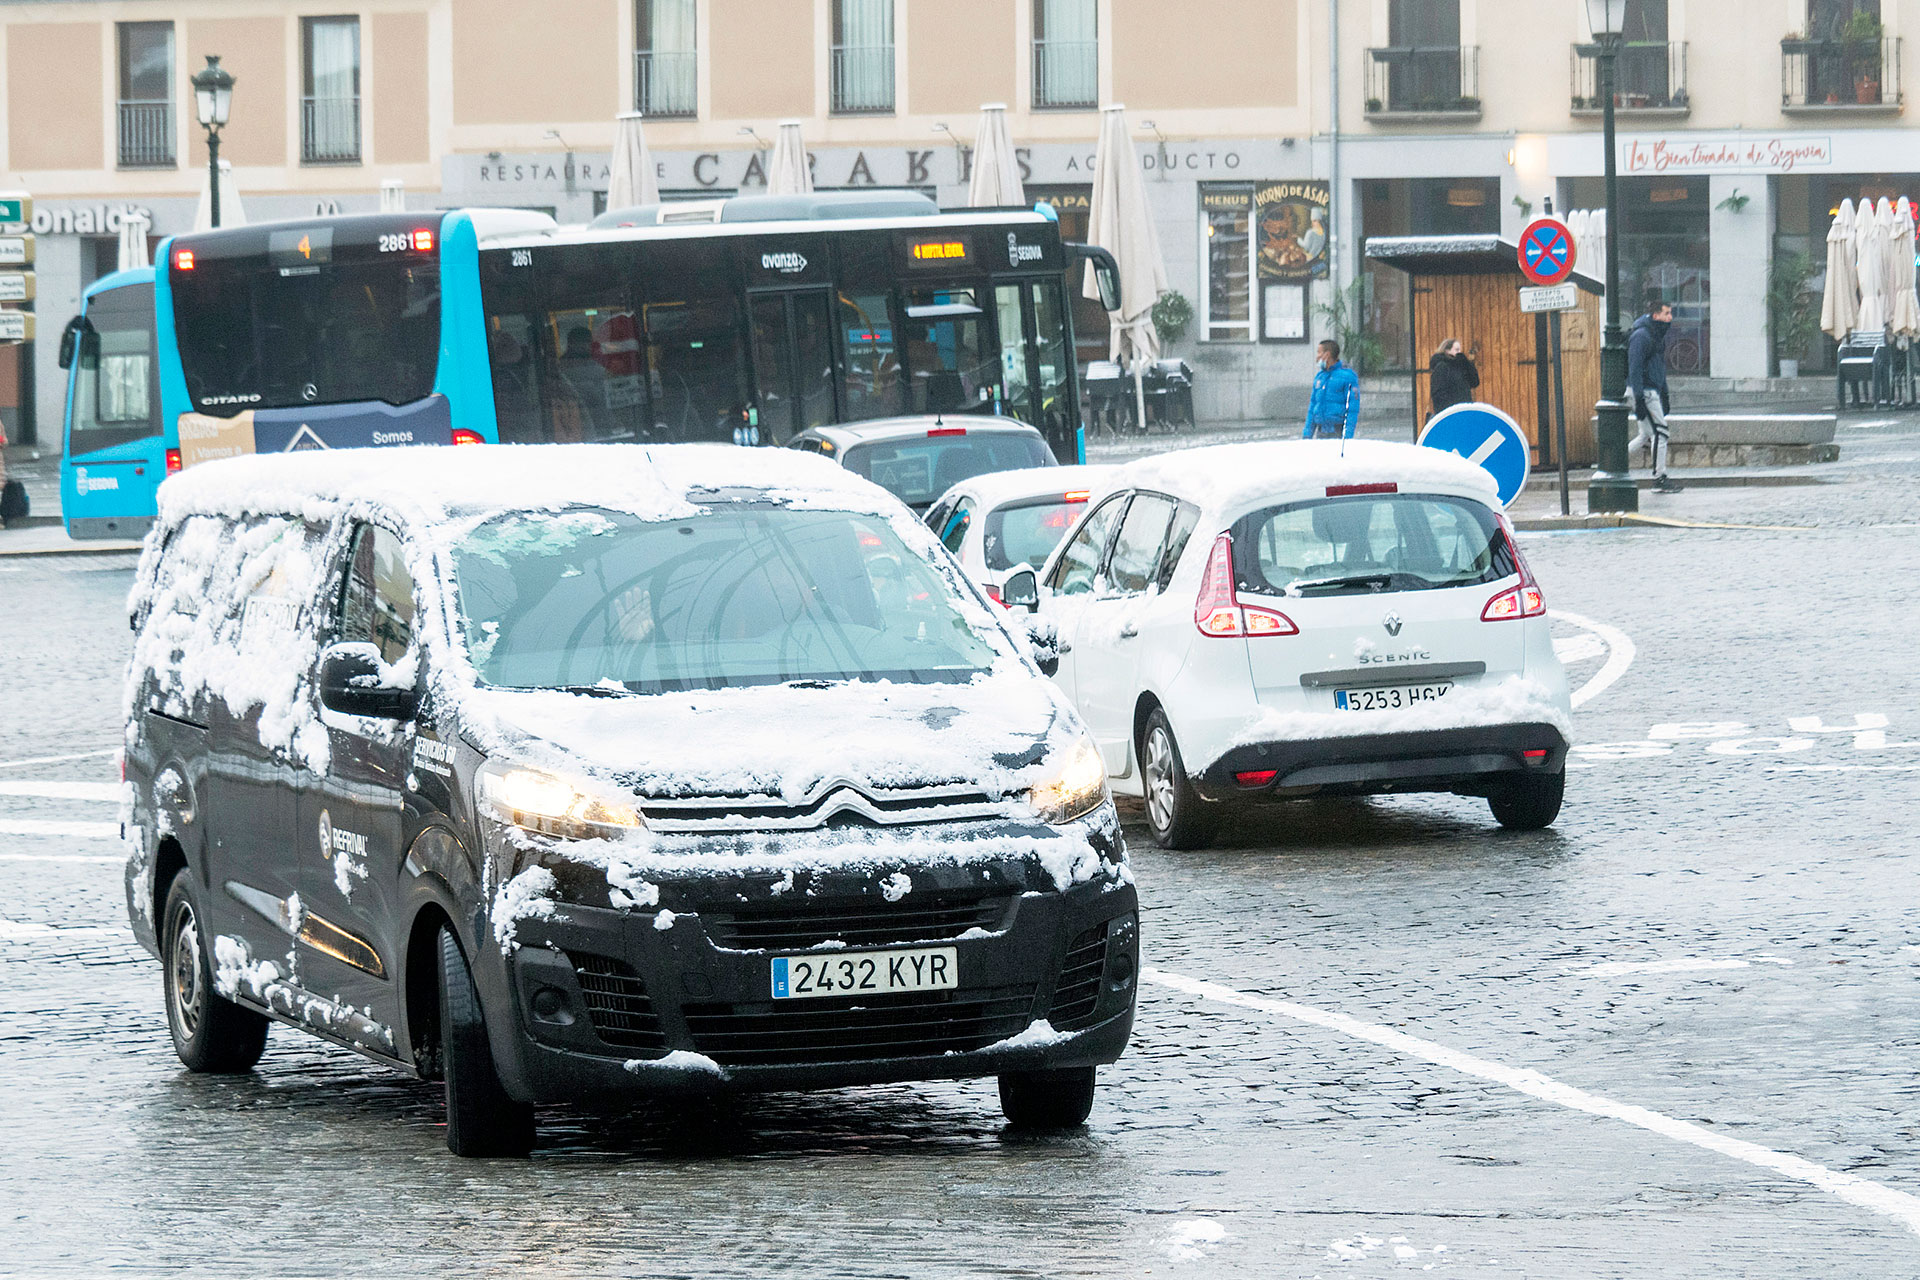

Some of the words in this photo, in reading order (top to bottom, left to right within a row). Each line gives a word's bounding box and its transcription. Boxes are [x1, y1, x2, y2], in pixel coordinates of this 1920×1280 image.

[1630, 139, 1648, 171] La
[1746, 143, 1763, 165] de
[1767, 139, 1825, 171] Segovia
[1204, 195, 1249, 206] MENUS
[1255, 184, 1289, 206] HORNO
[1289, 185, 1303, 197] DE
[298, 235, 311, 260] 4
[379, 233, 415, 252] 2861
[512, 249, 533, 267] 2861
[762, 252, 798, 268] avanza
[1018, 245, 1043, 261] SEGOVIA
[201, 393, 262, 406] CITARO
[372, 430, 414, 445] Somos
[1359, 651, 1431, 664] SCENIC
[1350, 689, 1402, 711] 5253
[333, 827, 367, 857] REFRIVAL
[795, 959, 876, 993] 2432
[889, 953, 948, 987] KYR
[778, 981, 785, 991] E
